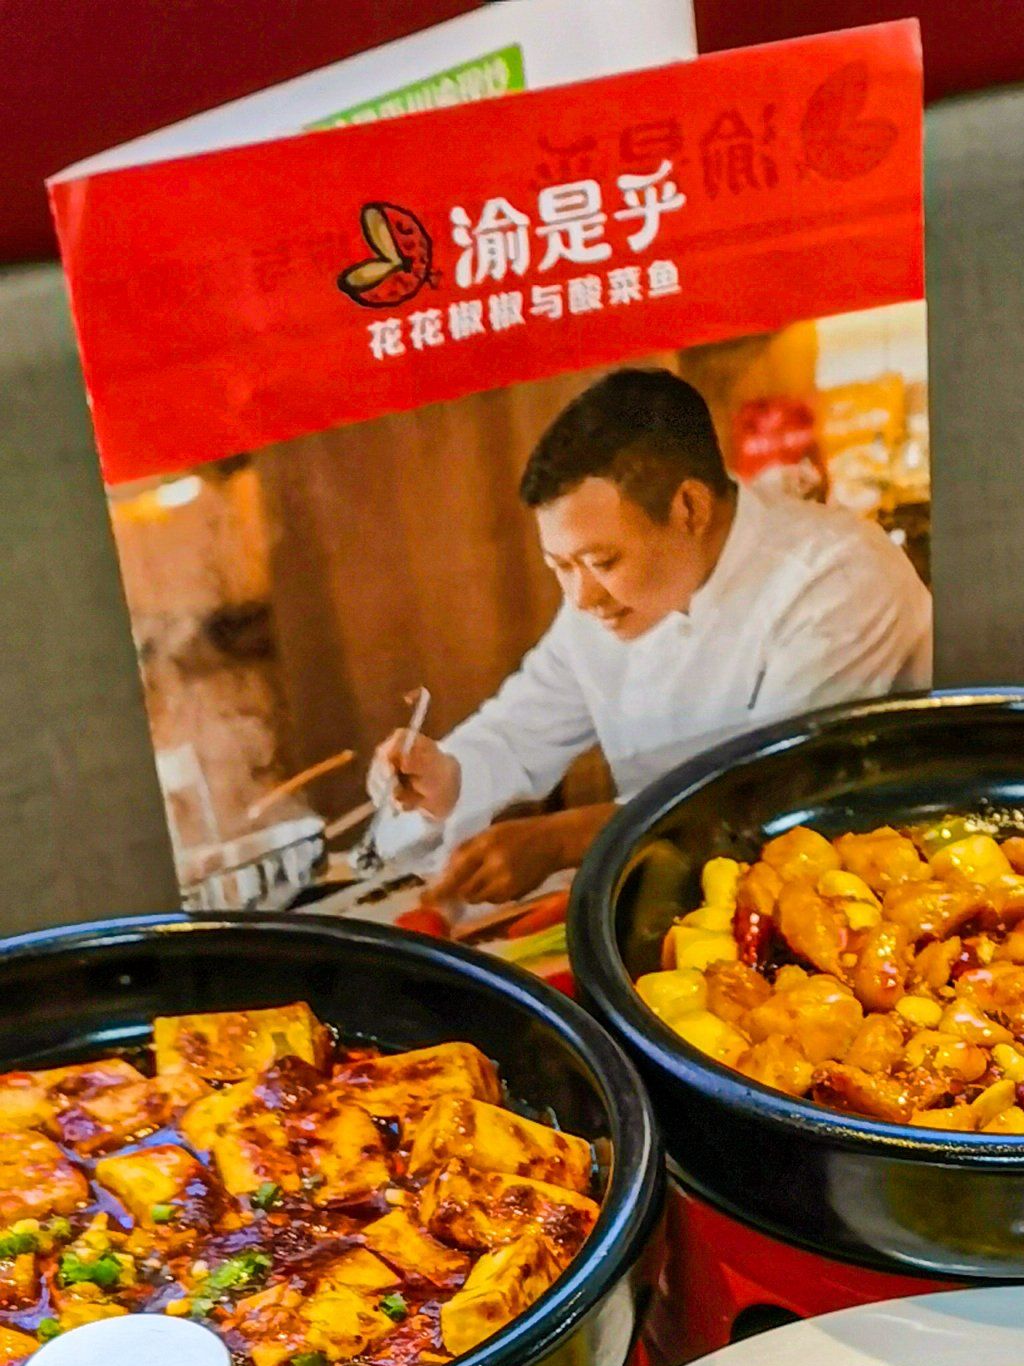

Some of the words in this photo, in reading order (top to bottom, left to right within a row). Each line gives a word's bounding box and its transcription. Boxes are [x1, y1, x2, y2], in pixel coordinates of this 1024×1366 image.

[450, 159, 687, 288] 渝是乎
[367, 260, 682, 360] 花花椒椒与酸菜鱼
